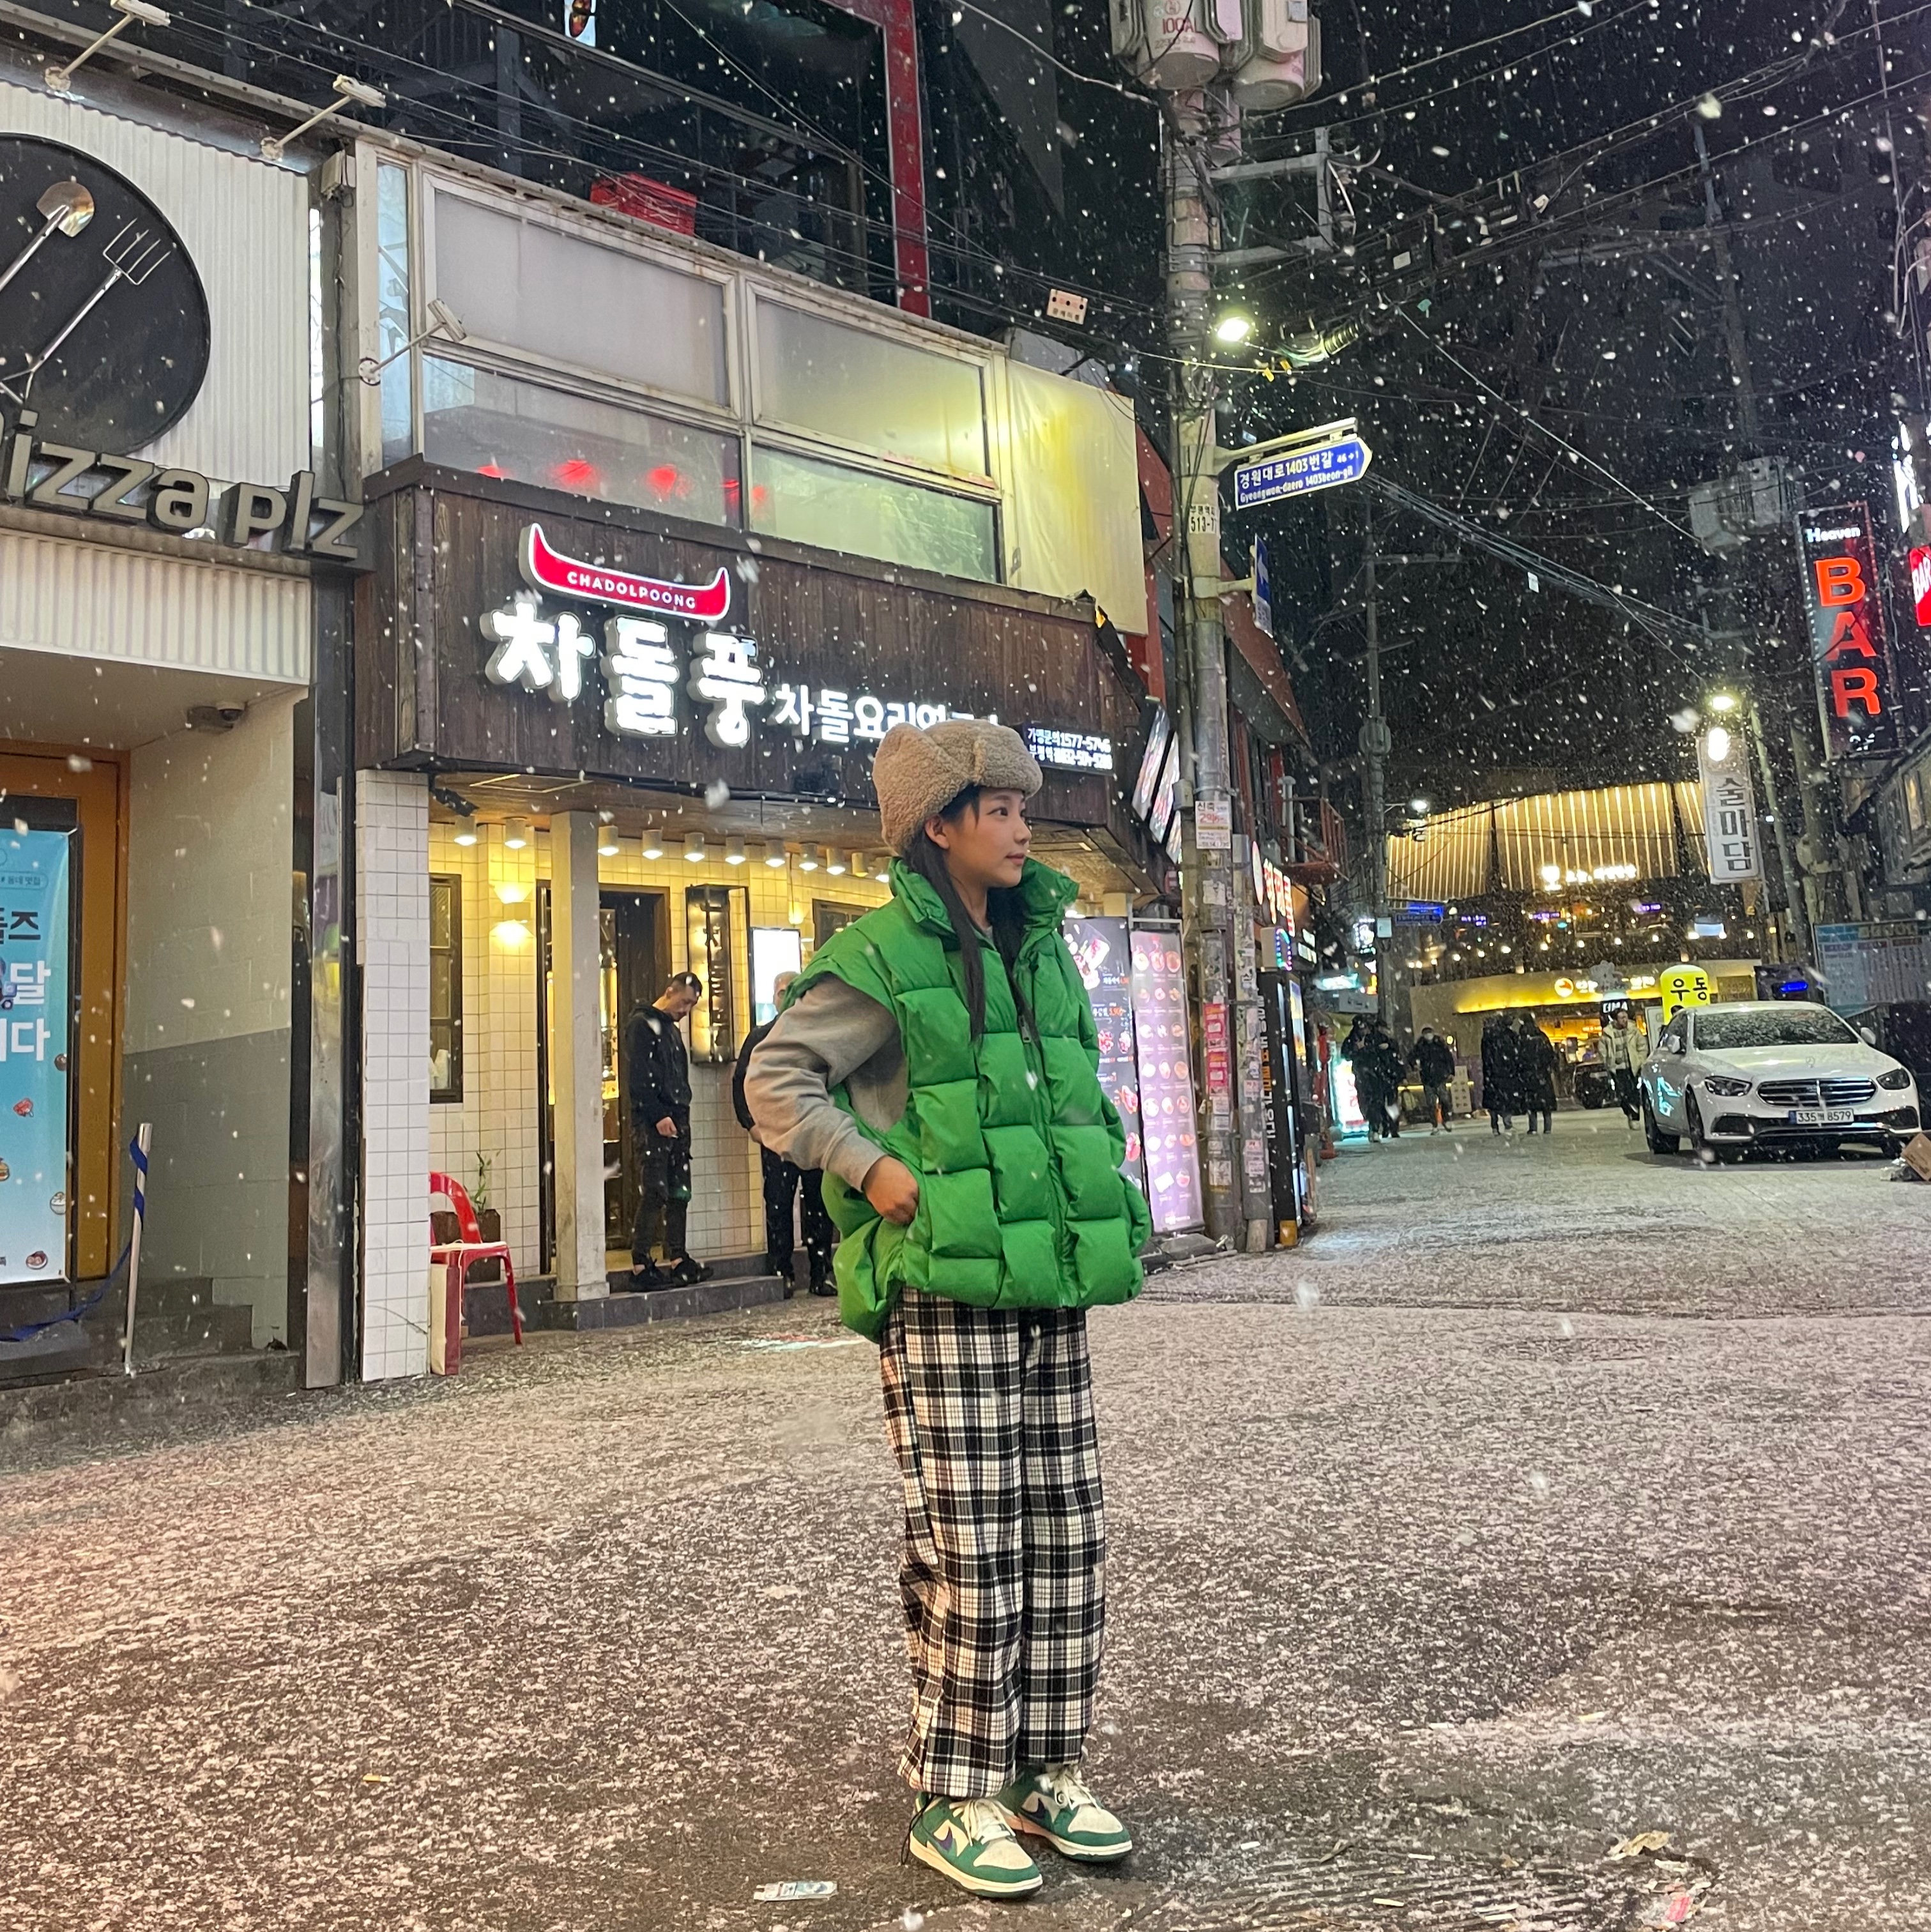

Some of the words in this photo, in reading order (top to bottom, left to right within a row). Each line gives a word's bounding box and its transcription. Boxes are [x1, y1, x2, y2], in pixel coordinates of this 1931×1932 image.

[0, 410, 210, 530] izza
[222, 471, 363, 560] plz
[1240, 451, 1334, 489] 경원대로1403번길
[1240, 480, 1303, 503] Gyeongwon-daero
[1305, 466, 1353, 487] 1403beon-gil
[1806, 527, 1861, 542] Heaven
[567, 570, 696, 609] CHADOLPOONG
[1815, 557, 1881, 718] BAR
[484, 600, 767, 747] 차돌풍
[0, 908, 41, 945] 즈
[1670, 977, 1707, 1001] 우동
[0, 1018, 51, 1061] 다
[1828, 1111, 1851, 1122] 8579
